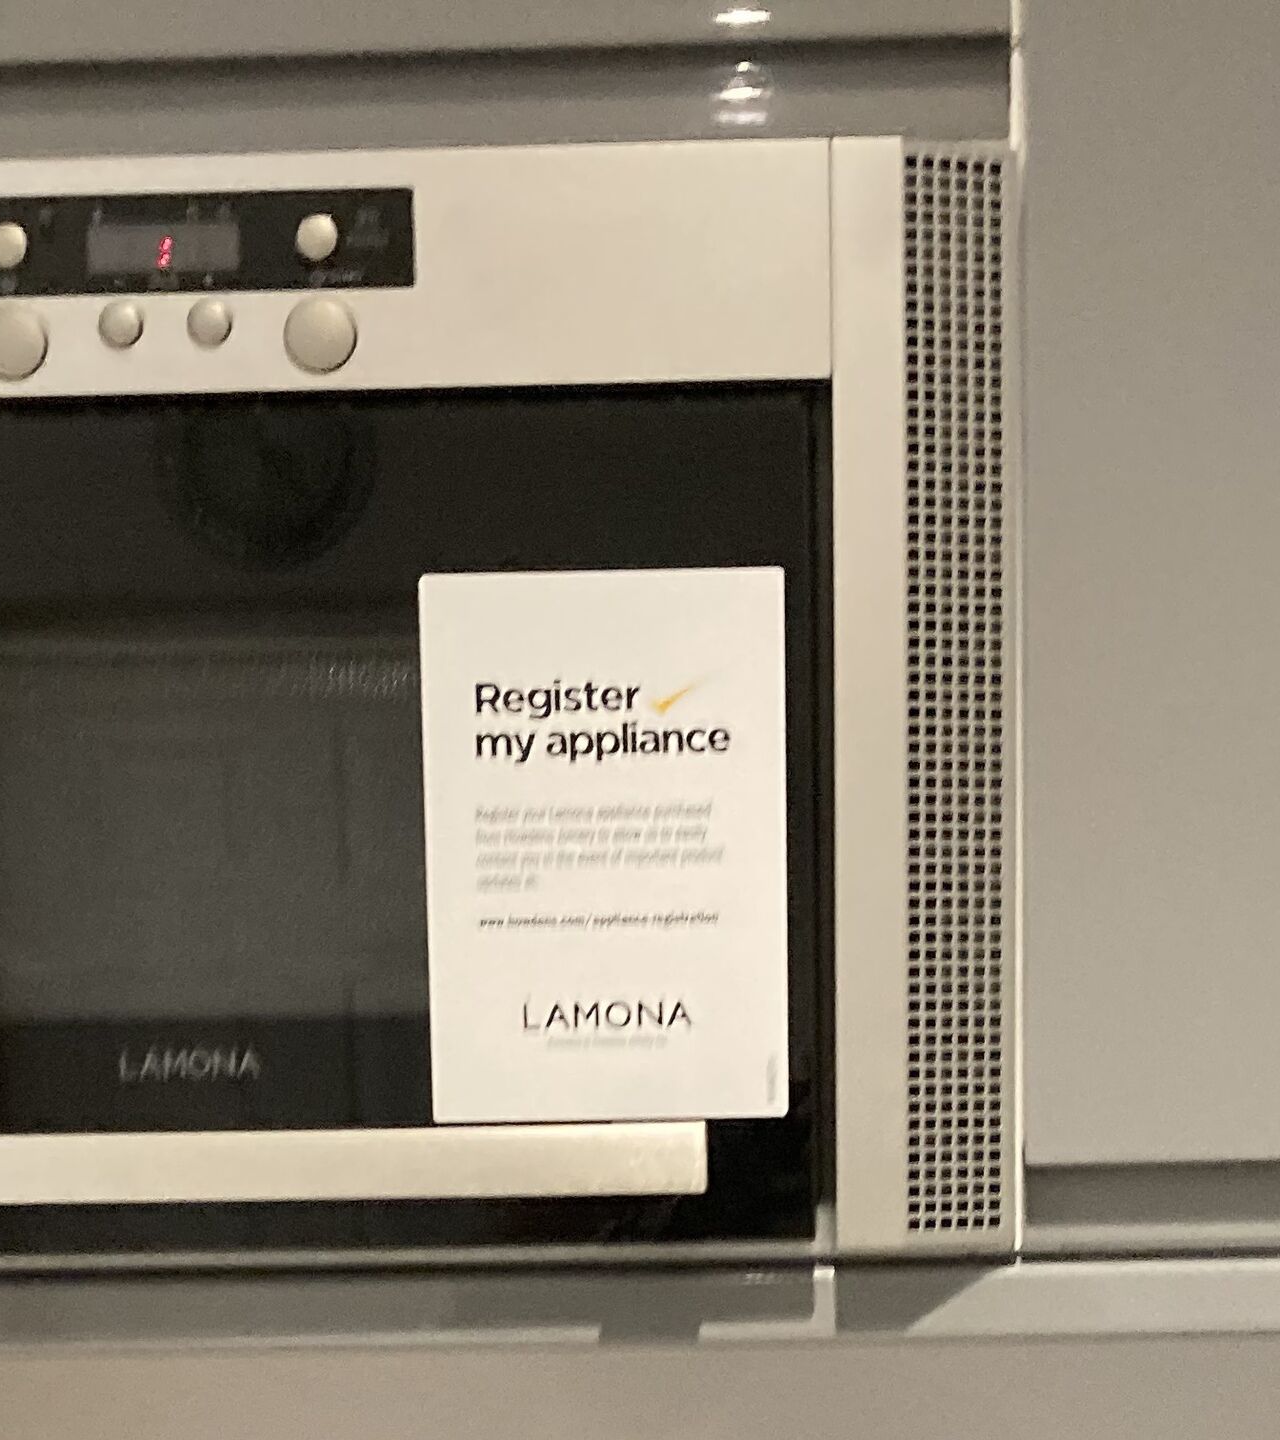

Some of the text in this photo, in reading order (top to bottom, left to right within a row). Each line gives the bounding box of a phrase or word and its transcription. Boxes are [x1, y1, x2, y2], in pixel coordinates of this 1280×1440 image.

[475, 680, 640, 719] Register
[475, 722, 731, 763] my appliance
[523, 1000, 692, 1030] LAMONA
[120, 1048, 261, 1081] LAMONA
